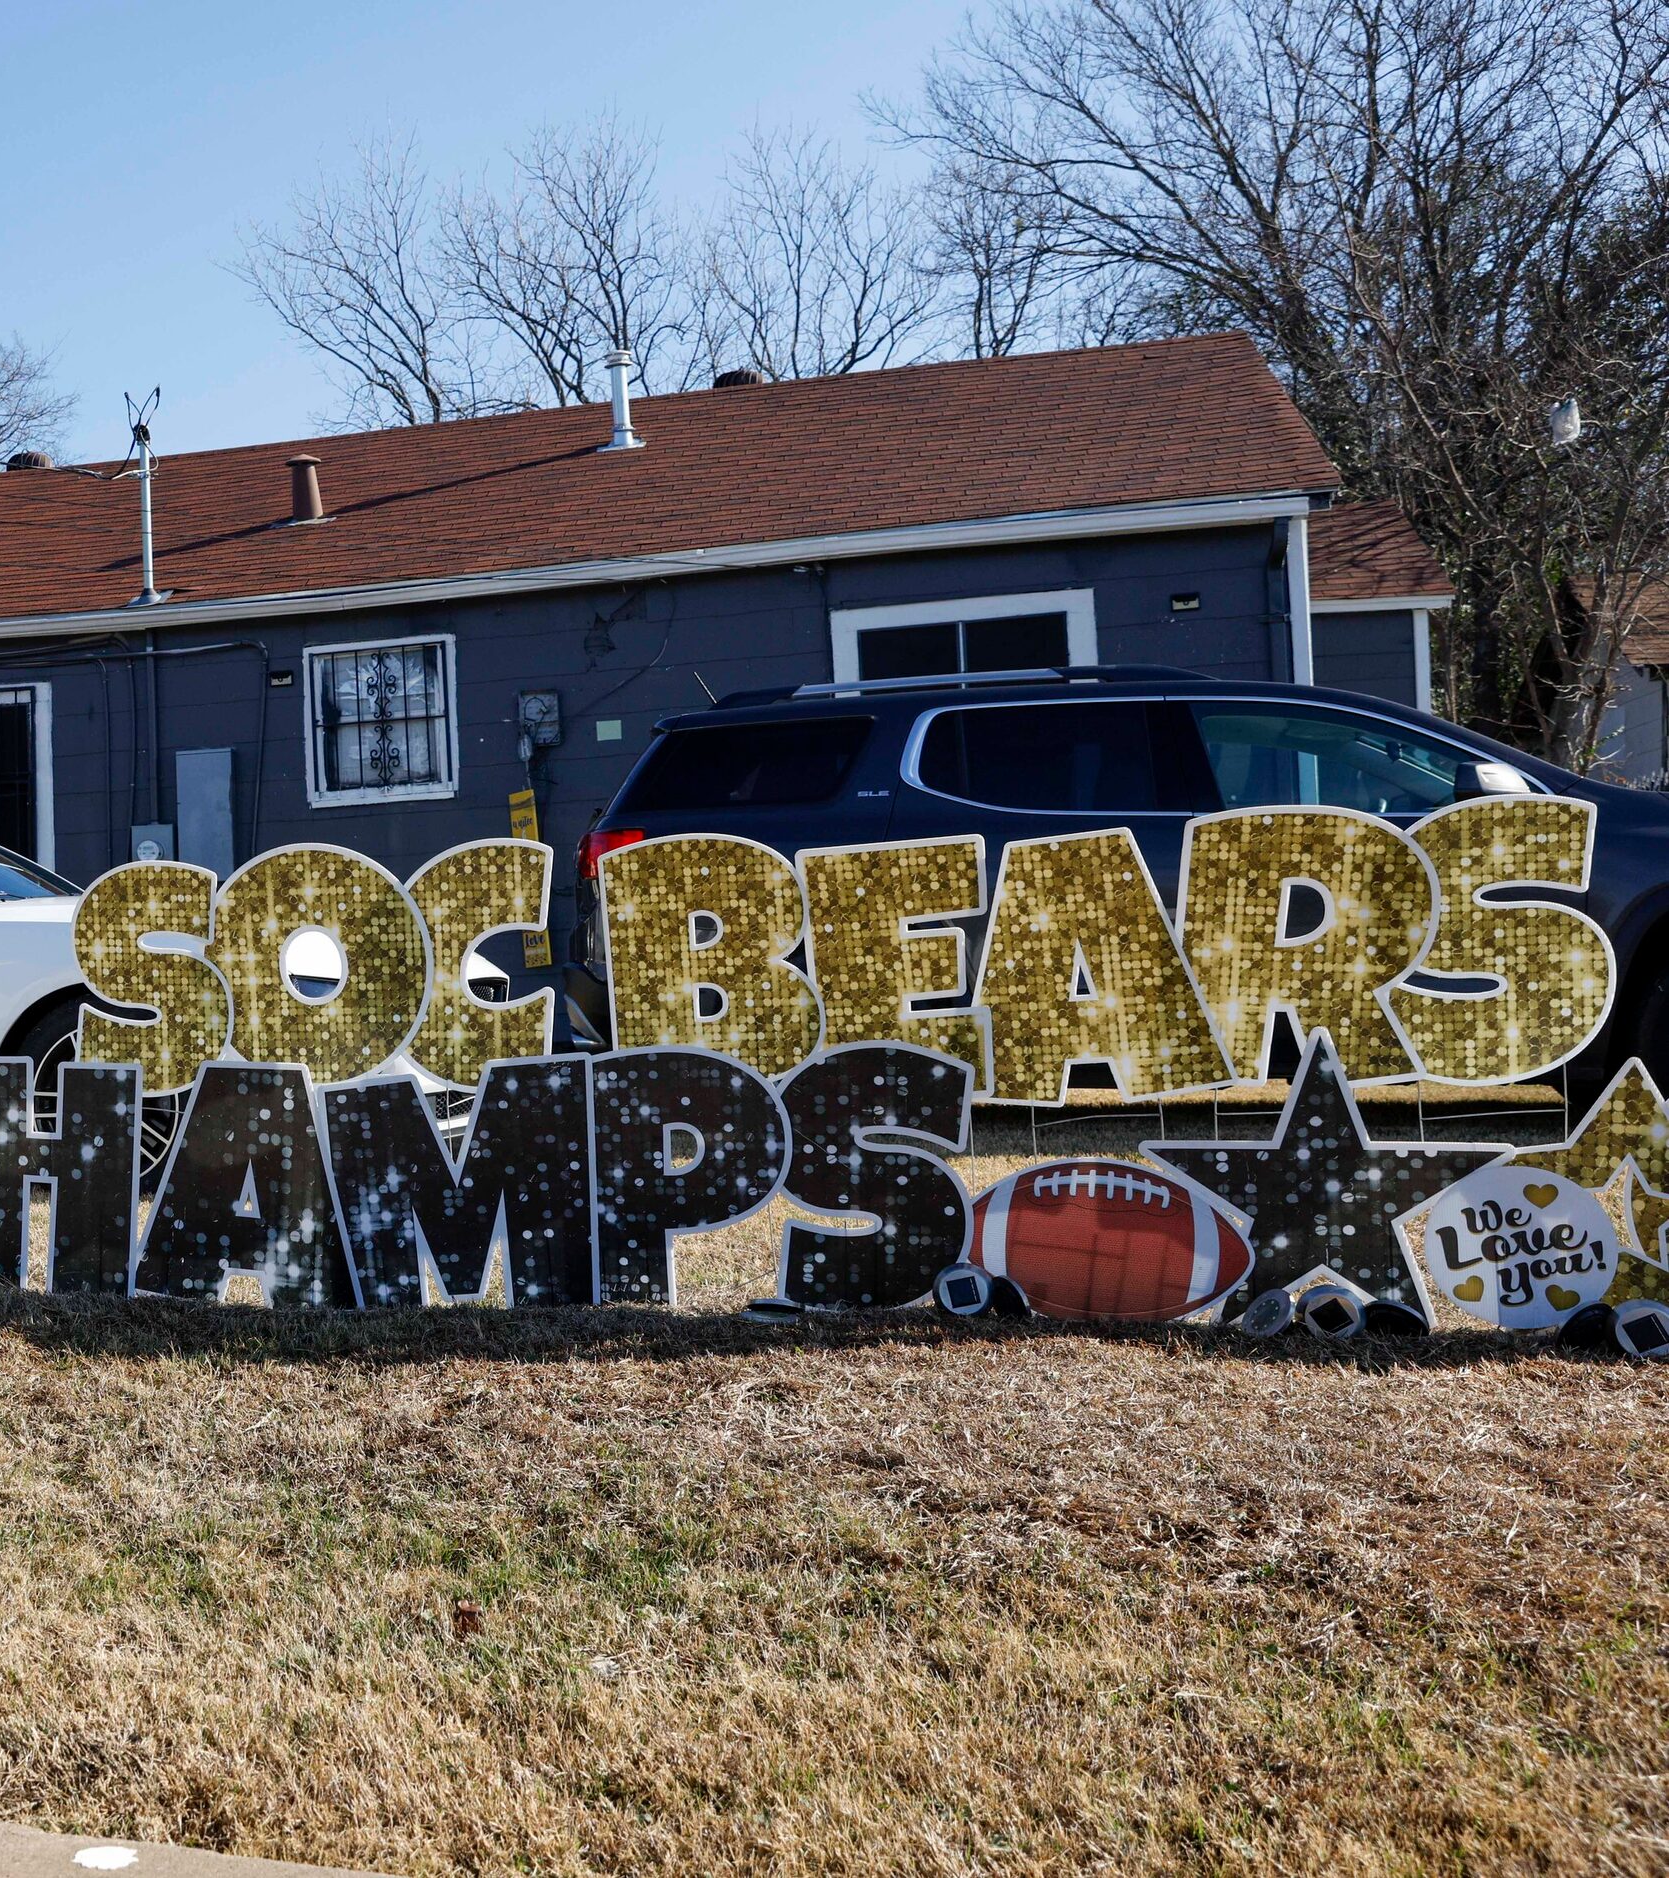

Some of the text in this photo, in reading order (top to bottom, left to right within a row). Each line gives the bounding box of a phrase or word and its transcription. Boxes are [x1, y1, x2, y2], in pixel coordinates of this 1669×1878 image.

[72, 837, 555, 1098] SOC
[597, 793, 1617, 1106] BEARS
[1461, 1200, 1532, 1234] We
[1435, 1223, 1588, 1271] Love
[1496, 1240, 1607, 1307] you!
